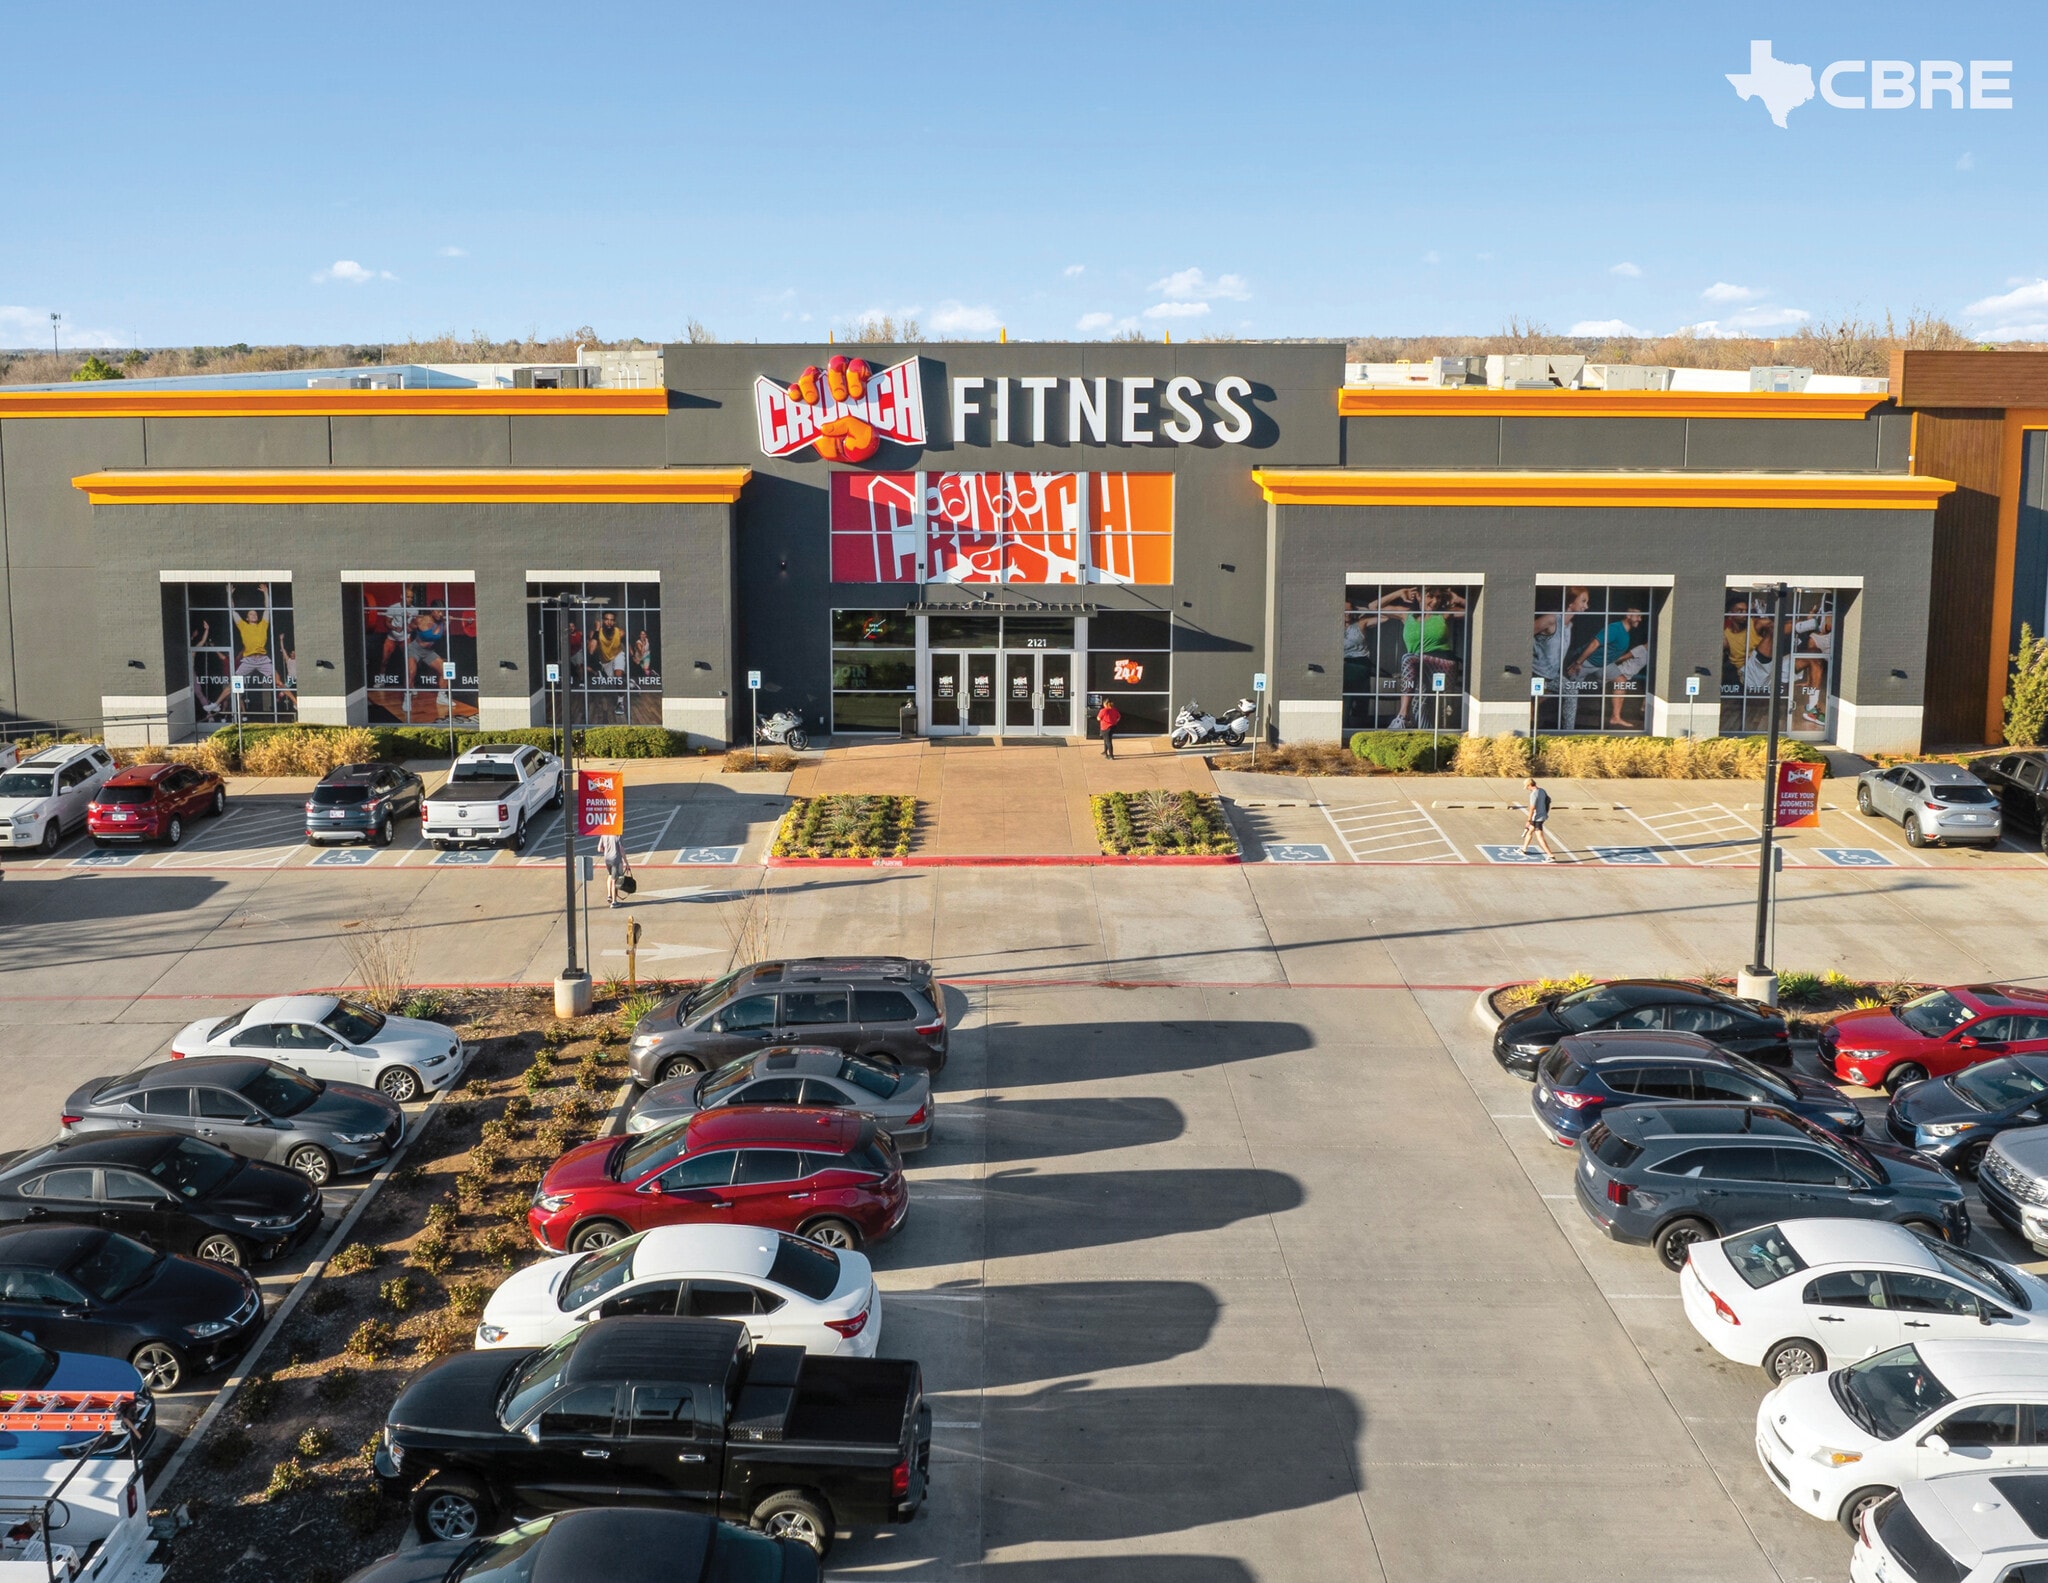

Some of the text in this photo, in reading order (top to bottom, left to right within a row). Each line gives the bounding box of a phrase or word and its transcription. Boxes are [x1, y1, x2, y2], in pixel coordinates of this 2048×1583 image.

[757, 361, 1253, 455] CRUNCH FITNESS
[1027, 638, 1047, 648] 2121
[1114, 665, 1143, 681] 24/7
[196, 675, 210, 685] LET
[210, 675, 229, 685] YOUR
[252, 675, 273, 685] FLAG
[286, 675, 297, 685] FL
[374, 675, 479, 685] RAISE THE BAR
[591, 676, 661, 686] STARTS HERE
[1383, 680, 1415, 689] FIT IN
[1566, 681, 1637, 690] STARTS HERE
[1720, 684, 1740, 693] YOUR
[1749, 685, 1762, 694] FIT
[1801, 686, 1817, 696] FLY
[586, 798, 617, 806] PARKING
[1779, 800, 1814, 808] JUDGMENTS
[586, 813, 617, 825] ONLY
